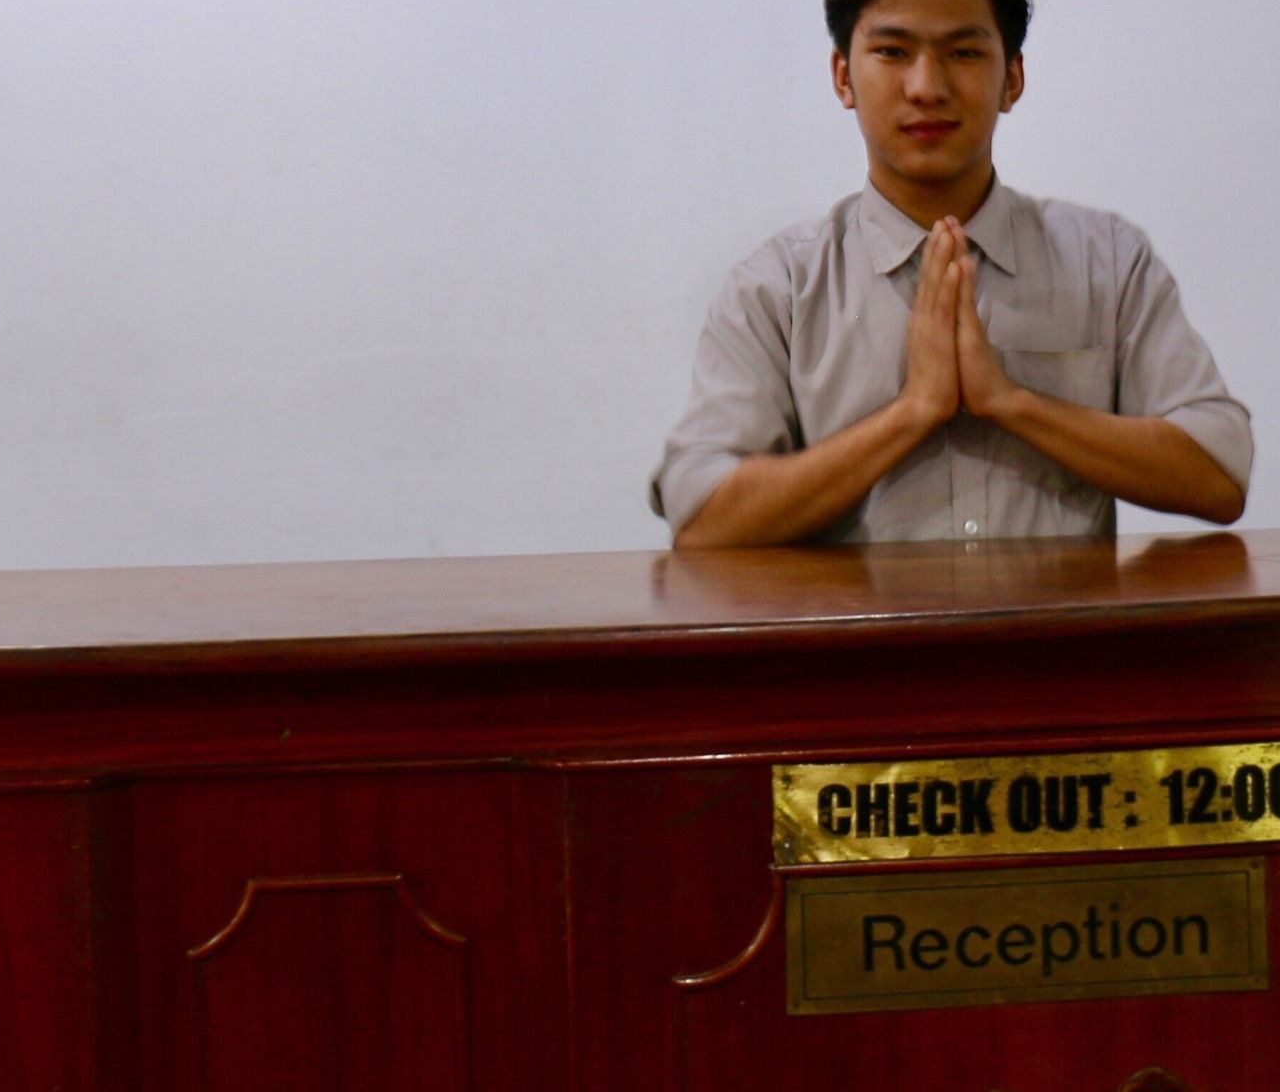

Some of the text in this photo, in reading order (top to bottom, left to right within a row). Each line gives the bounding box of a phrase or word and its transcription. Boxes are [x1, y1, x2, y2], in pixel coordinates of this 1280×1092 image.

[817, 779, 996, 839] CHECK
[1006, 772, 1113, 833] OUT
[860, 904, 1211, 977] Reception
